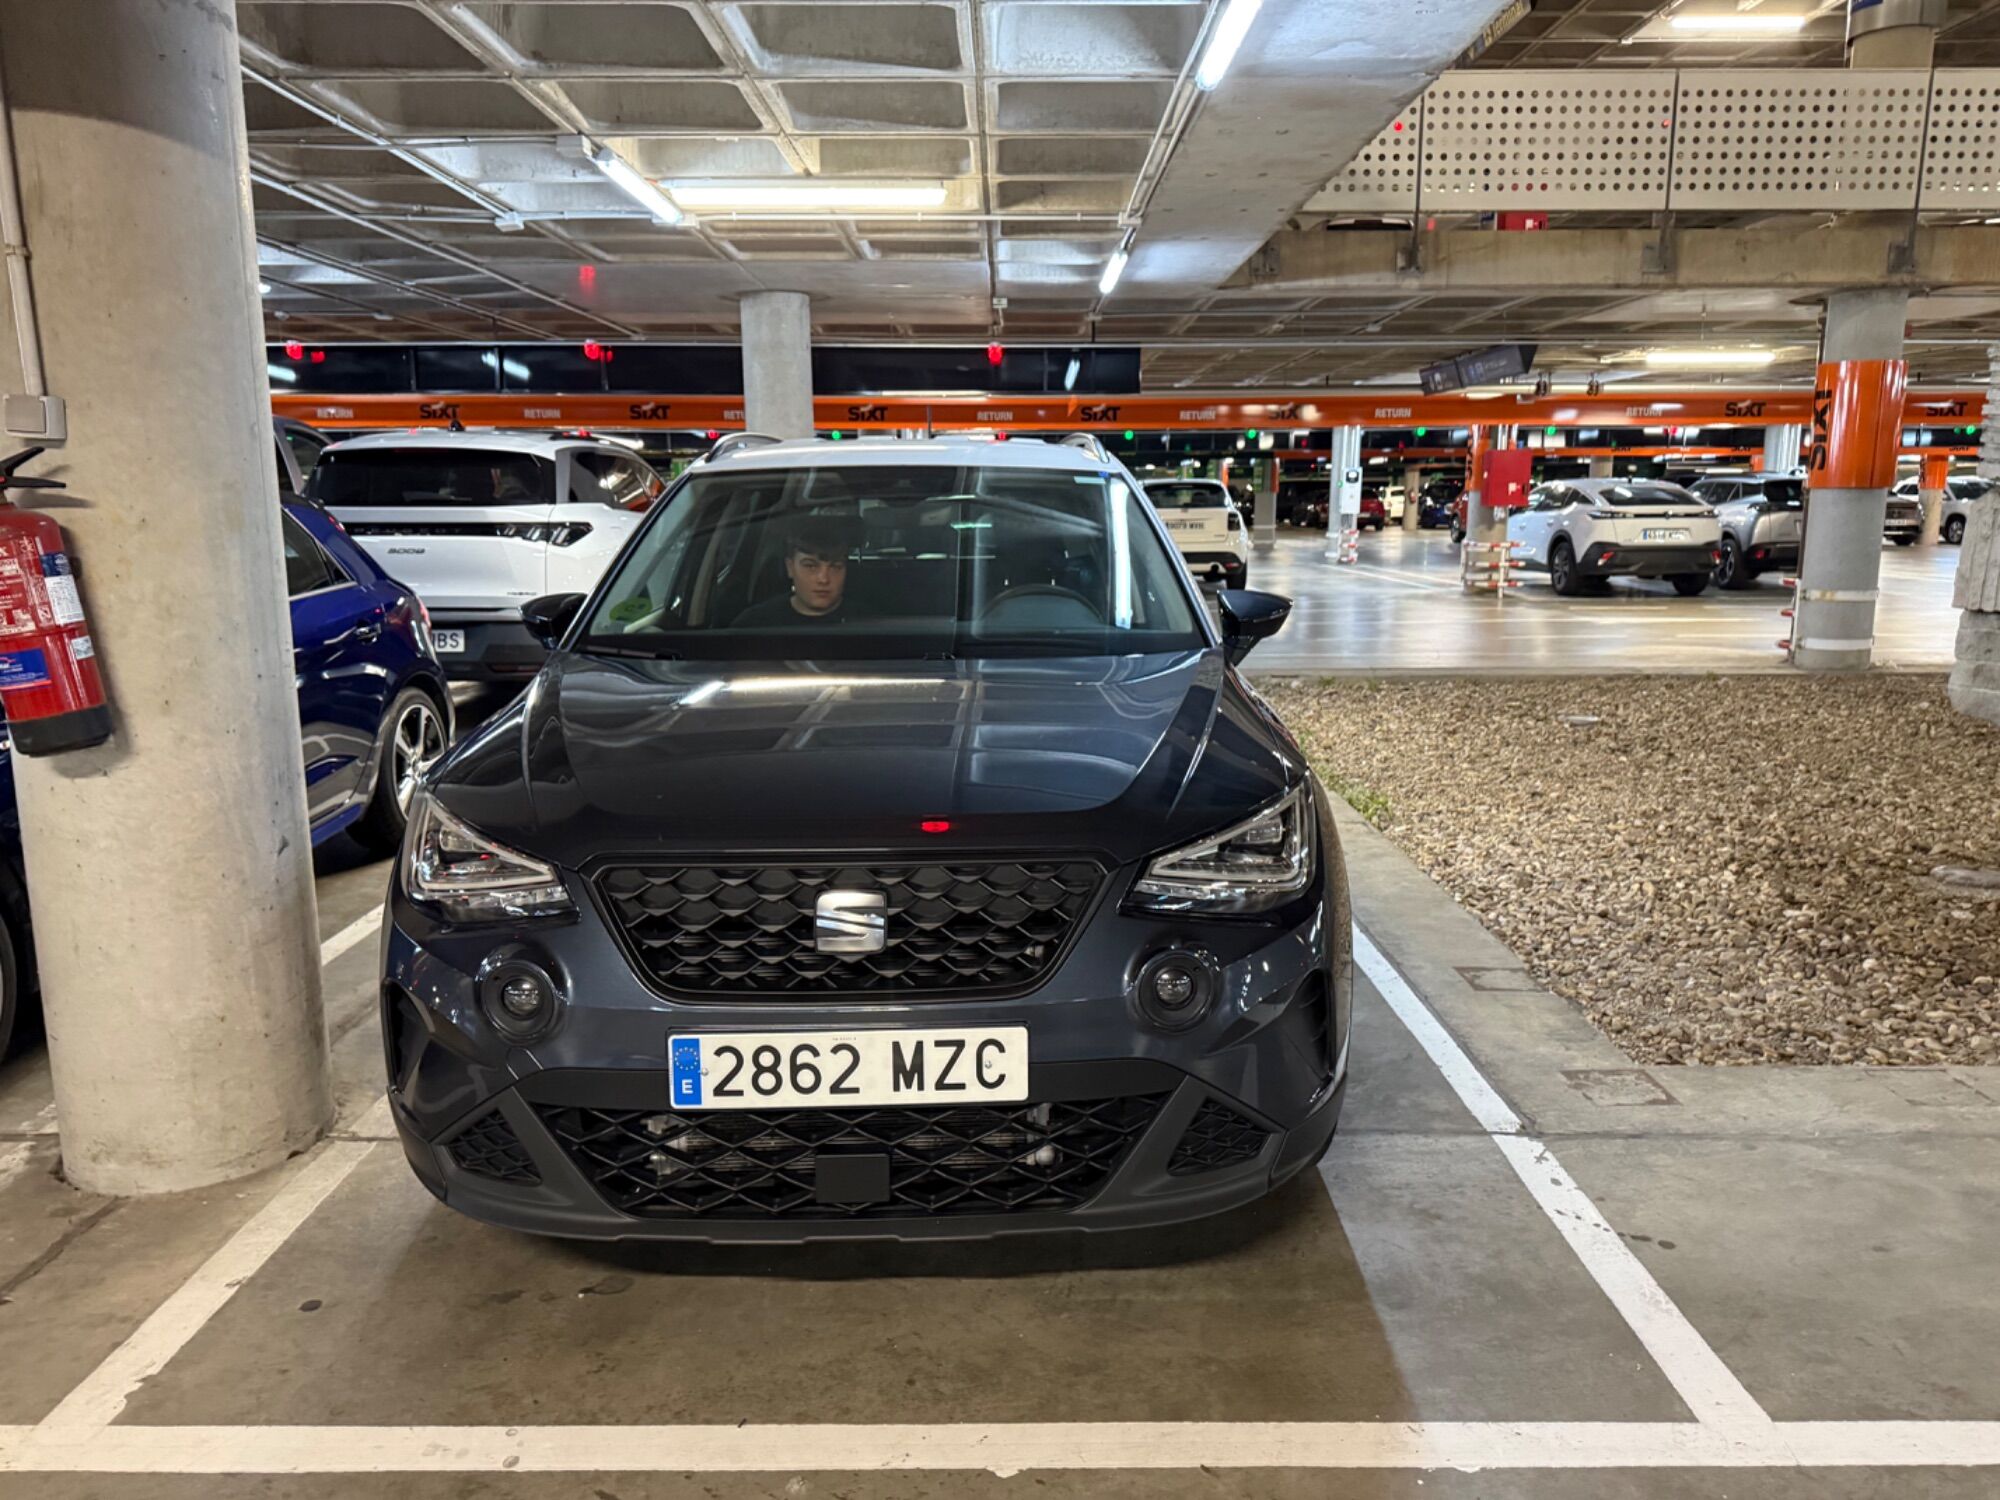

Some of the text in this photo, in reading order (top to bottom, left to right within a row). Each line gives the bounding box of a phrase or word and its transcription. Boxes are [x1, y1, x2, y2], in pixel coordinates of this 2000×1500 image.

[420, 402, 460, 419] SIXT
[524, 409, 561, 419] RETURN
[630, 402, 670, 419] SIXT
[848, 404, 888, 421] SIXT
[977, 411, 1013, 421] RETURN
[1081, 404, 1120, 421] SIXT
[1179, 410, 1216, 420] RETURN
[1375, 408, 1411, 418] RETURN
[1625, 407, 1662, 417] RETURN
[1725, 401, 1766, 417] SIXT
[1926, 402, 1968, 417] SIXT
[1810, 390, 1832, 471] SIXT
[712, 1038, 1007, 1097] 2862 MZC
[682, 1079, 693, 1094] E
